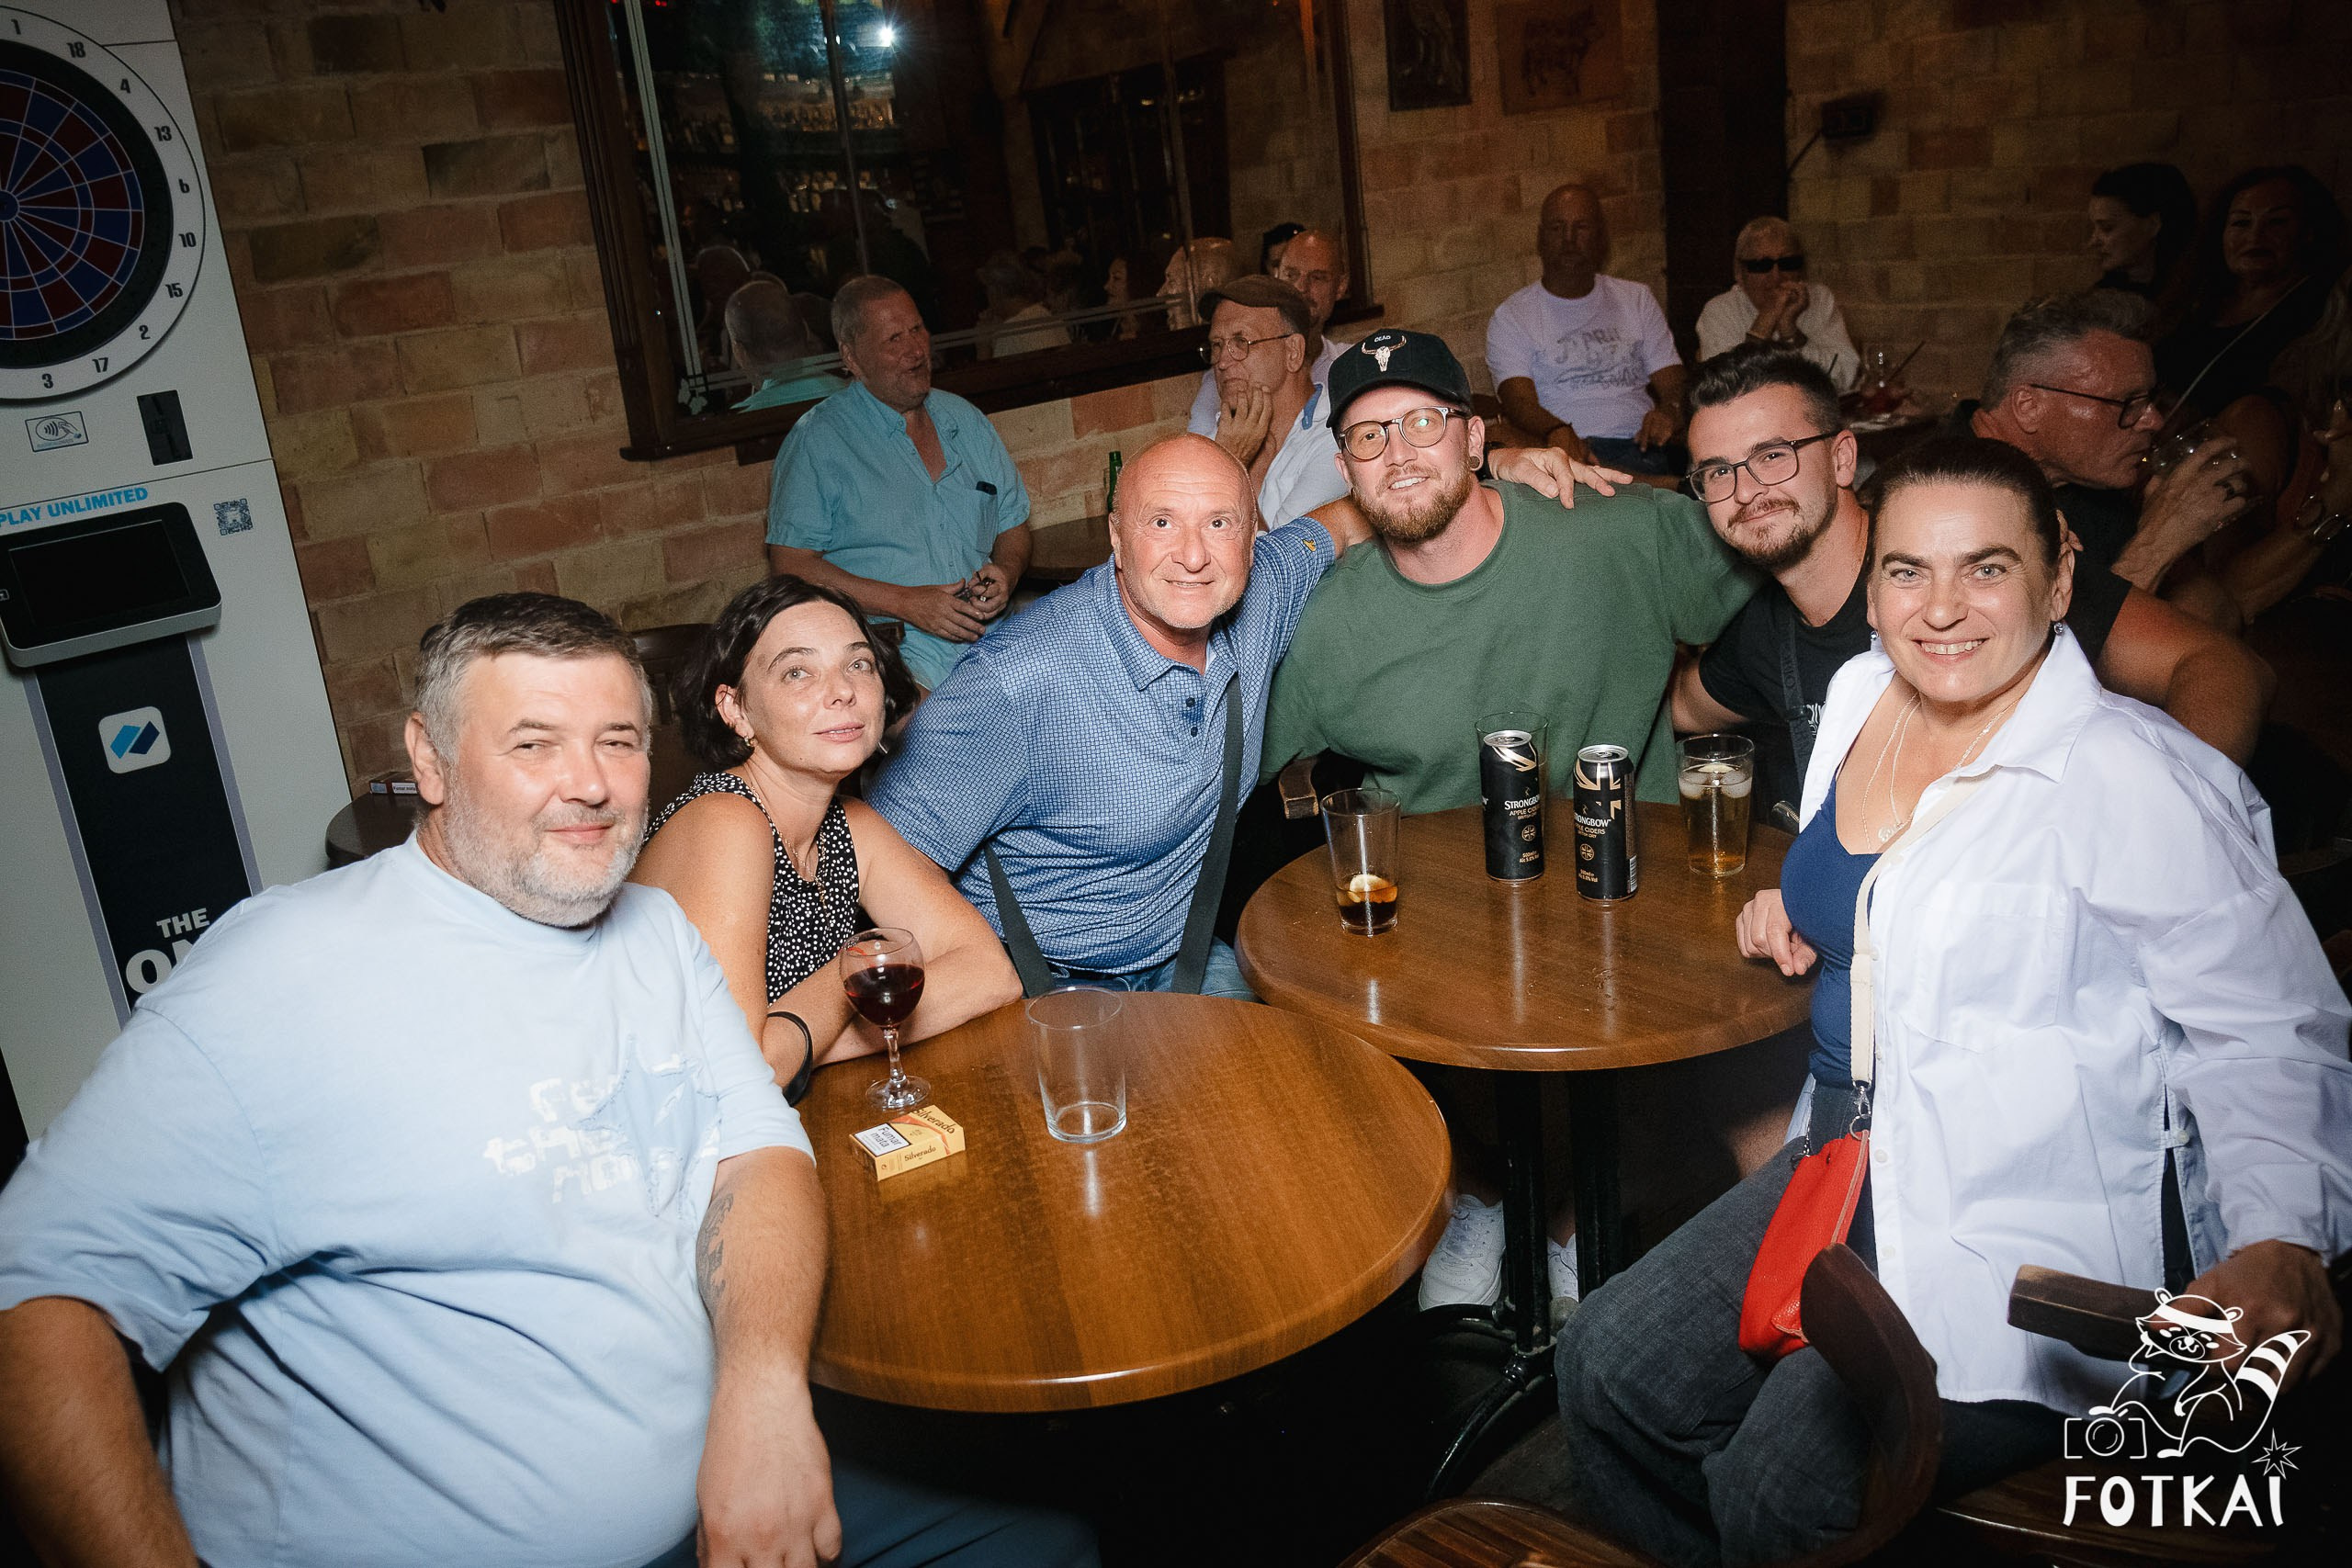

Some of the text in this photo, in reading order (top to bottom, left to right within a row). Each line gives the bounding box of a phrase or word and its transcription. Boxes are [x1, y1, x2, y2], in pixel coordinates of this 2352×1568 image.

[11, 18, 21, 35] 1
[66, 41, 86, 58] 18
[120, 78, 130, 94] 4
[154, 126, 172, 141] 13
[178, 178, 190, 193] 6
[178, 231, 197, 248] 10
[165, 282, 183, 299] 15
[139, 324, 151, 340] 2
[92, 356, 108, 373] 17
[41, 373, 54, 389] 3
[0, 487, 148, 527] PLAY UNLIMITED
[1504, 794, 1540, 810] STRONGBO
[1510, 808, 1527, 817] APPLE
[1584, 827, 1606, 835] CIDERS
[156, 908, 209, 938] THE
[912, 1109, 956, 1134] Silverado
[871, 1133, 890, 1147] mata
[878, 1126, 903, 1145] Fumar
[904, 1145, 936, 1162] Silverado
